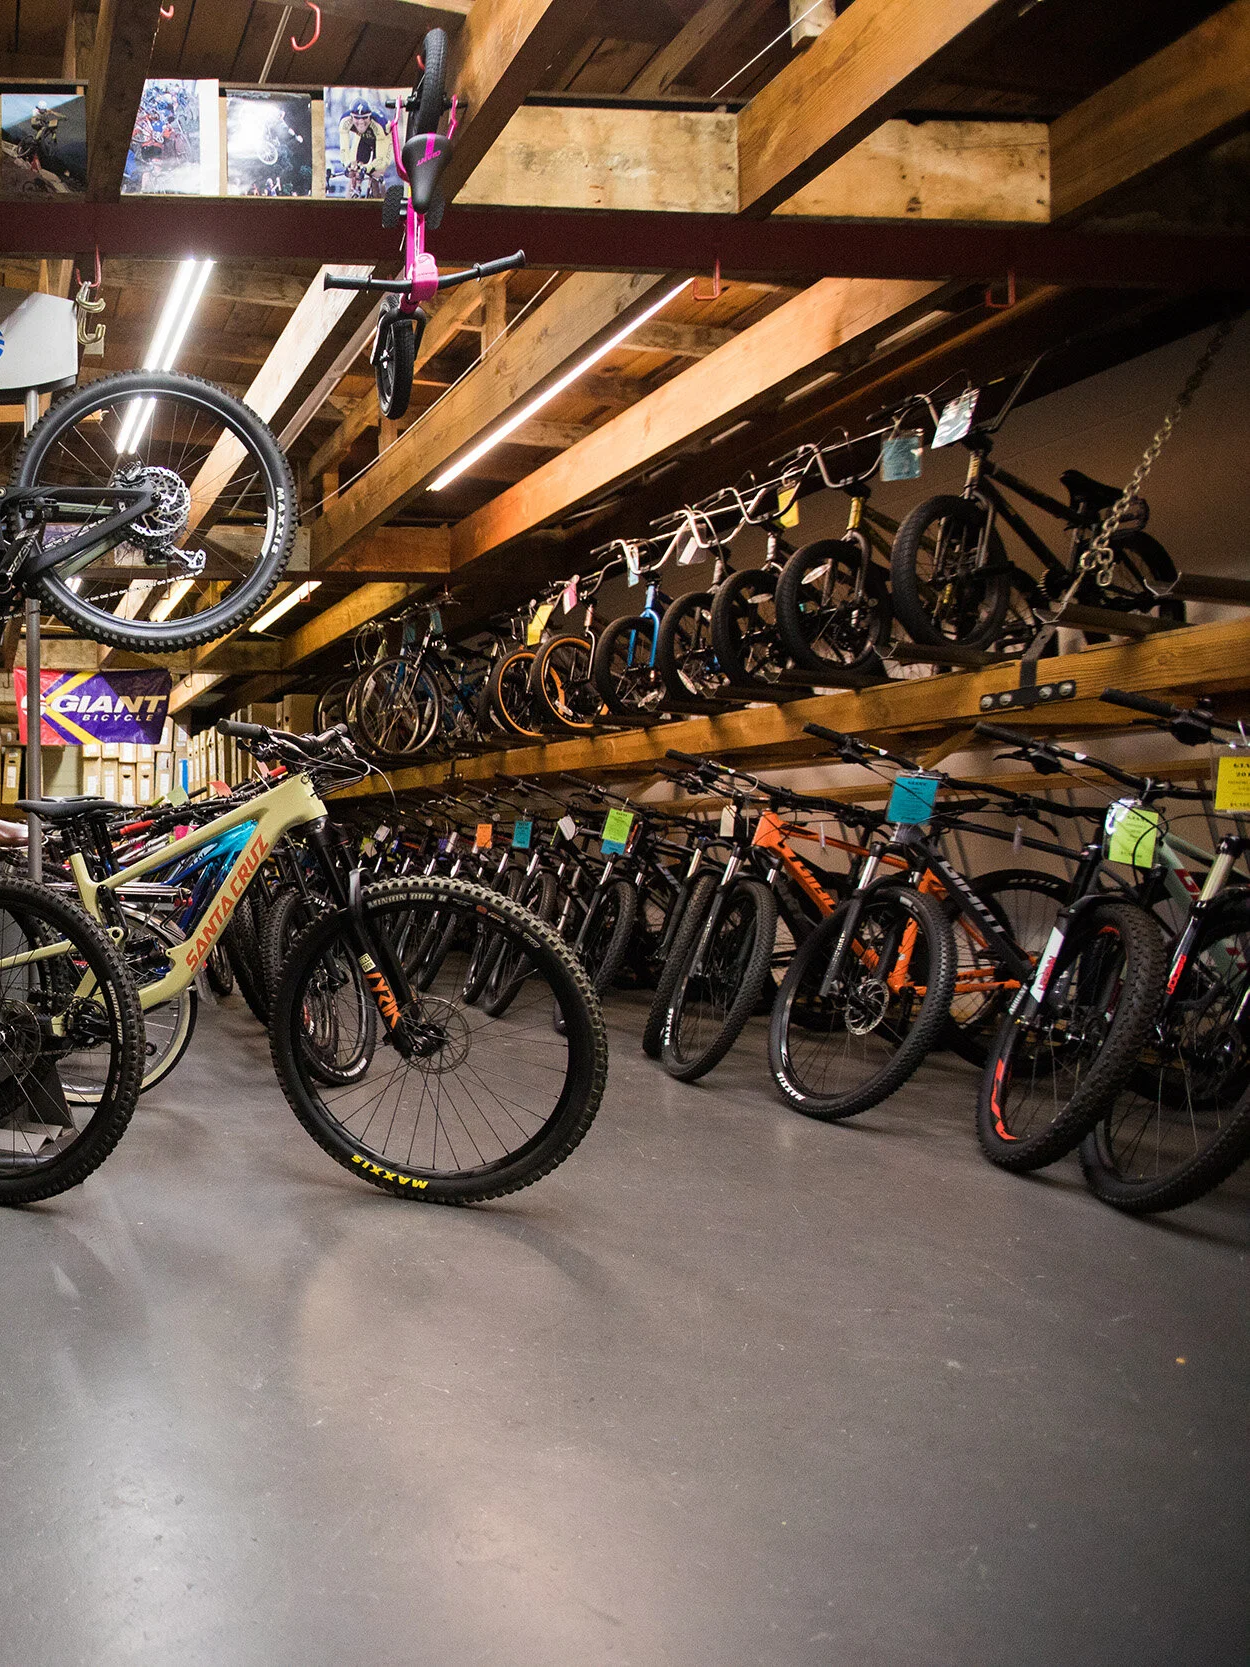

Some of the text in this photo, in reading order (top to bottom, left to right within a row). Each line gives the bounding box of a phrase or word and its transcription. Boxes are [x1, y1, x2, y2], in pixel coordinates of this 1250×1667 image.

[416, 150, 441, 166] GIANT
[270, 487, 286, 555] MAXXIS
[51, 694, 167, 713] GIANT
[82, 713, 154, 722] BICYCLE
[185, 834, 270, 972] SANTA CRUZ
[366, 893, 408, 909] MINION
[663, 1007, 674, 1046] MAXXIS
[776, 1071, 807, 1102] MAXXIS
[351, 1154, 429, 1190] MAXXIS
